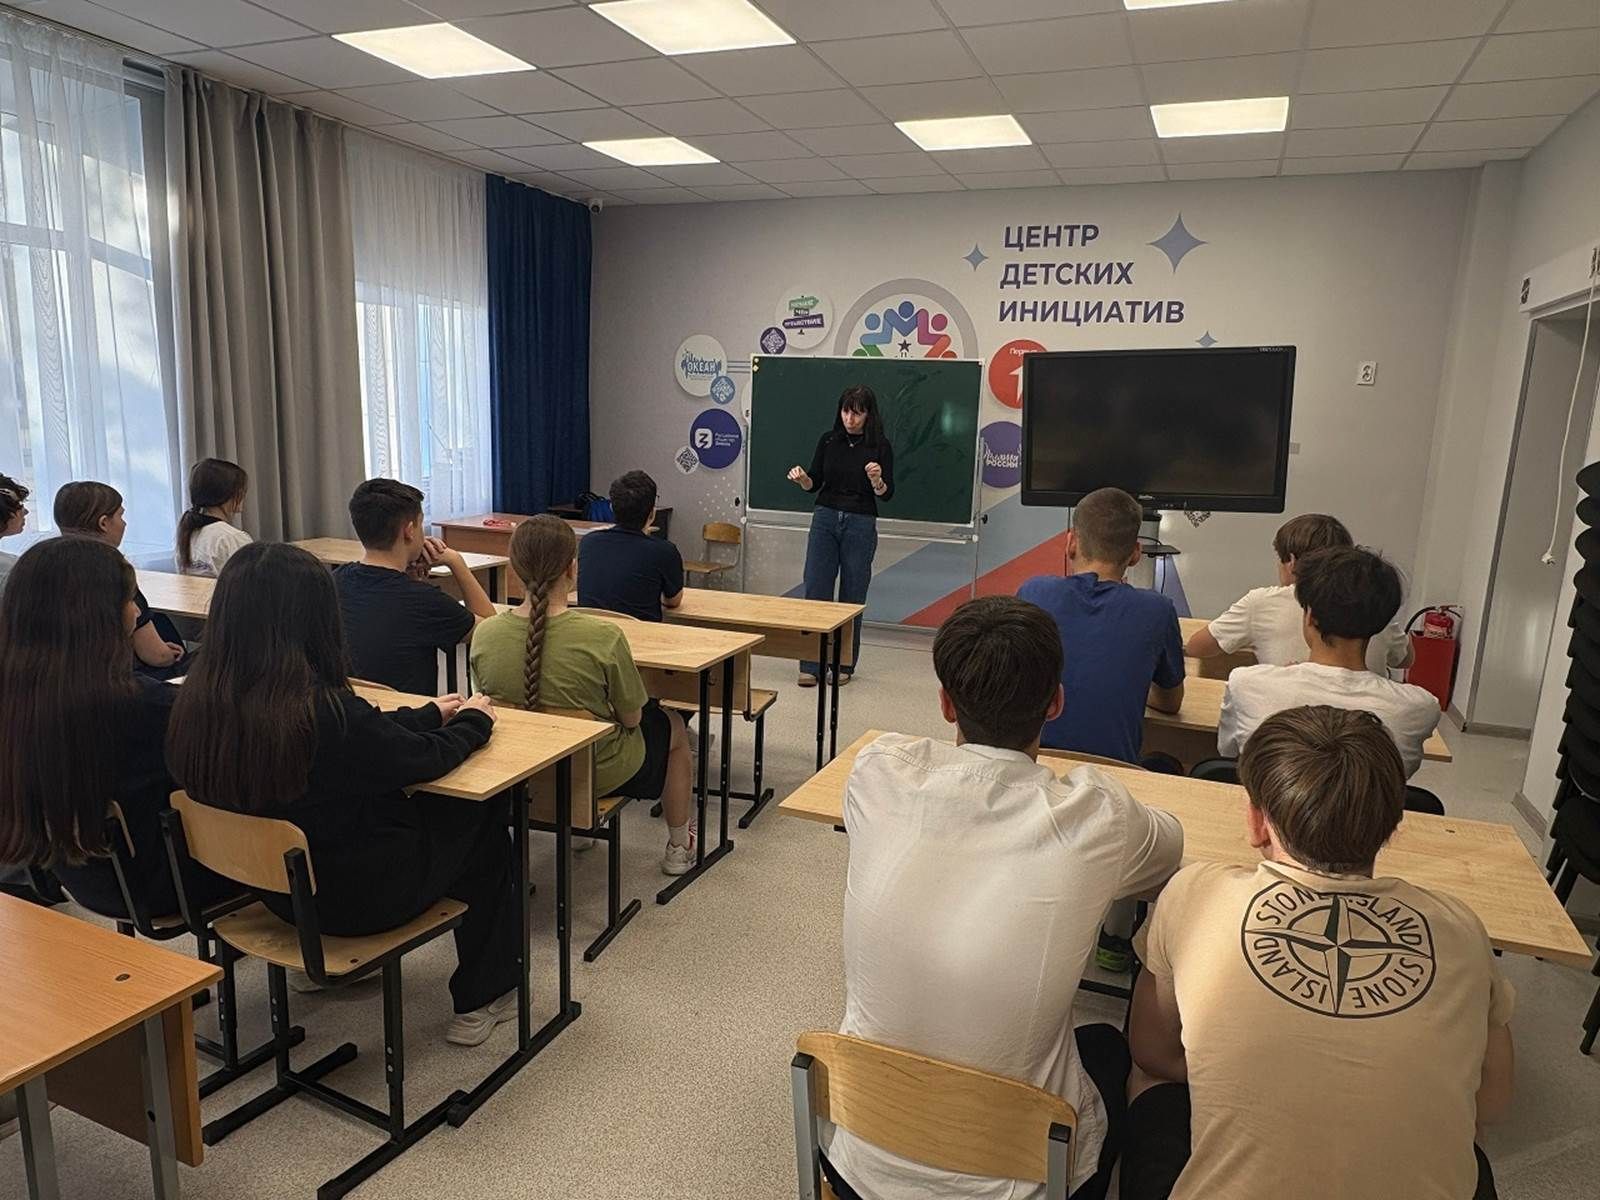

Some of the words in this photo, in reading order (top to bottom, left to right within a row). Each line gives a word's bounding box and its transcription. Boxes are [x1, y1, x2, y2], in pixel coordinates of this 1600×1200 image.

[1004, 224, 1099, 252] ЦЕНТР
[1000, 262, 1134, 289] ДЕТСКИХ
[999, 300, 1184, 326] ИНИЦИАТИВ
[687, 361, 716, 372] ОКЕАН
[1348, 897, 1422, 946] LAND
[1254, 936, 1327, 1004] ISLAND
[1349, 957, 1425, 1009] STONE
